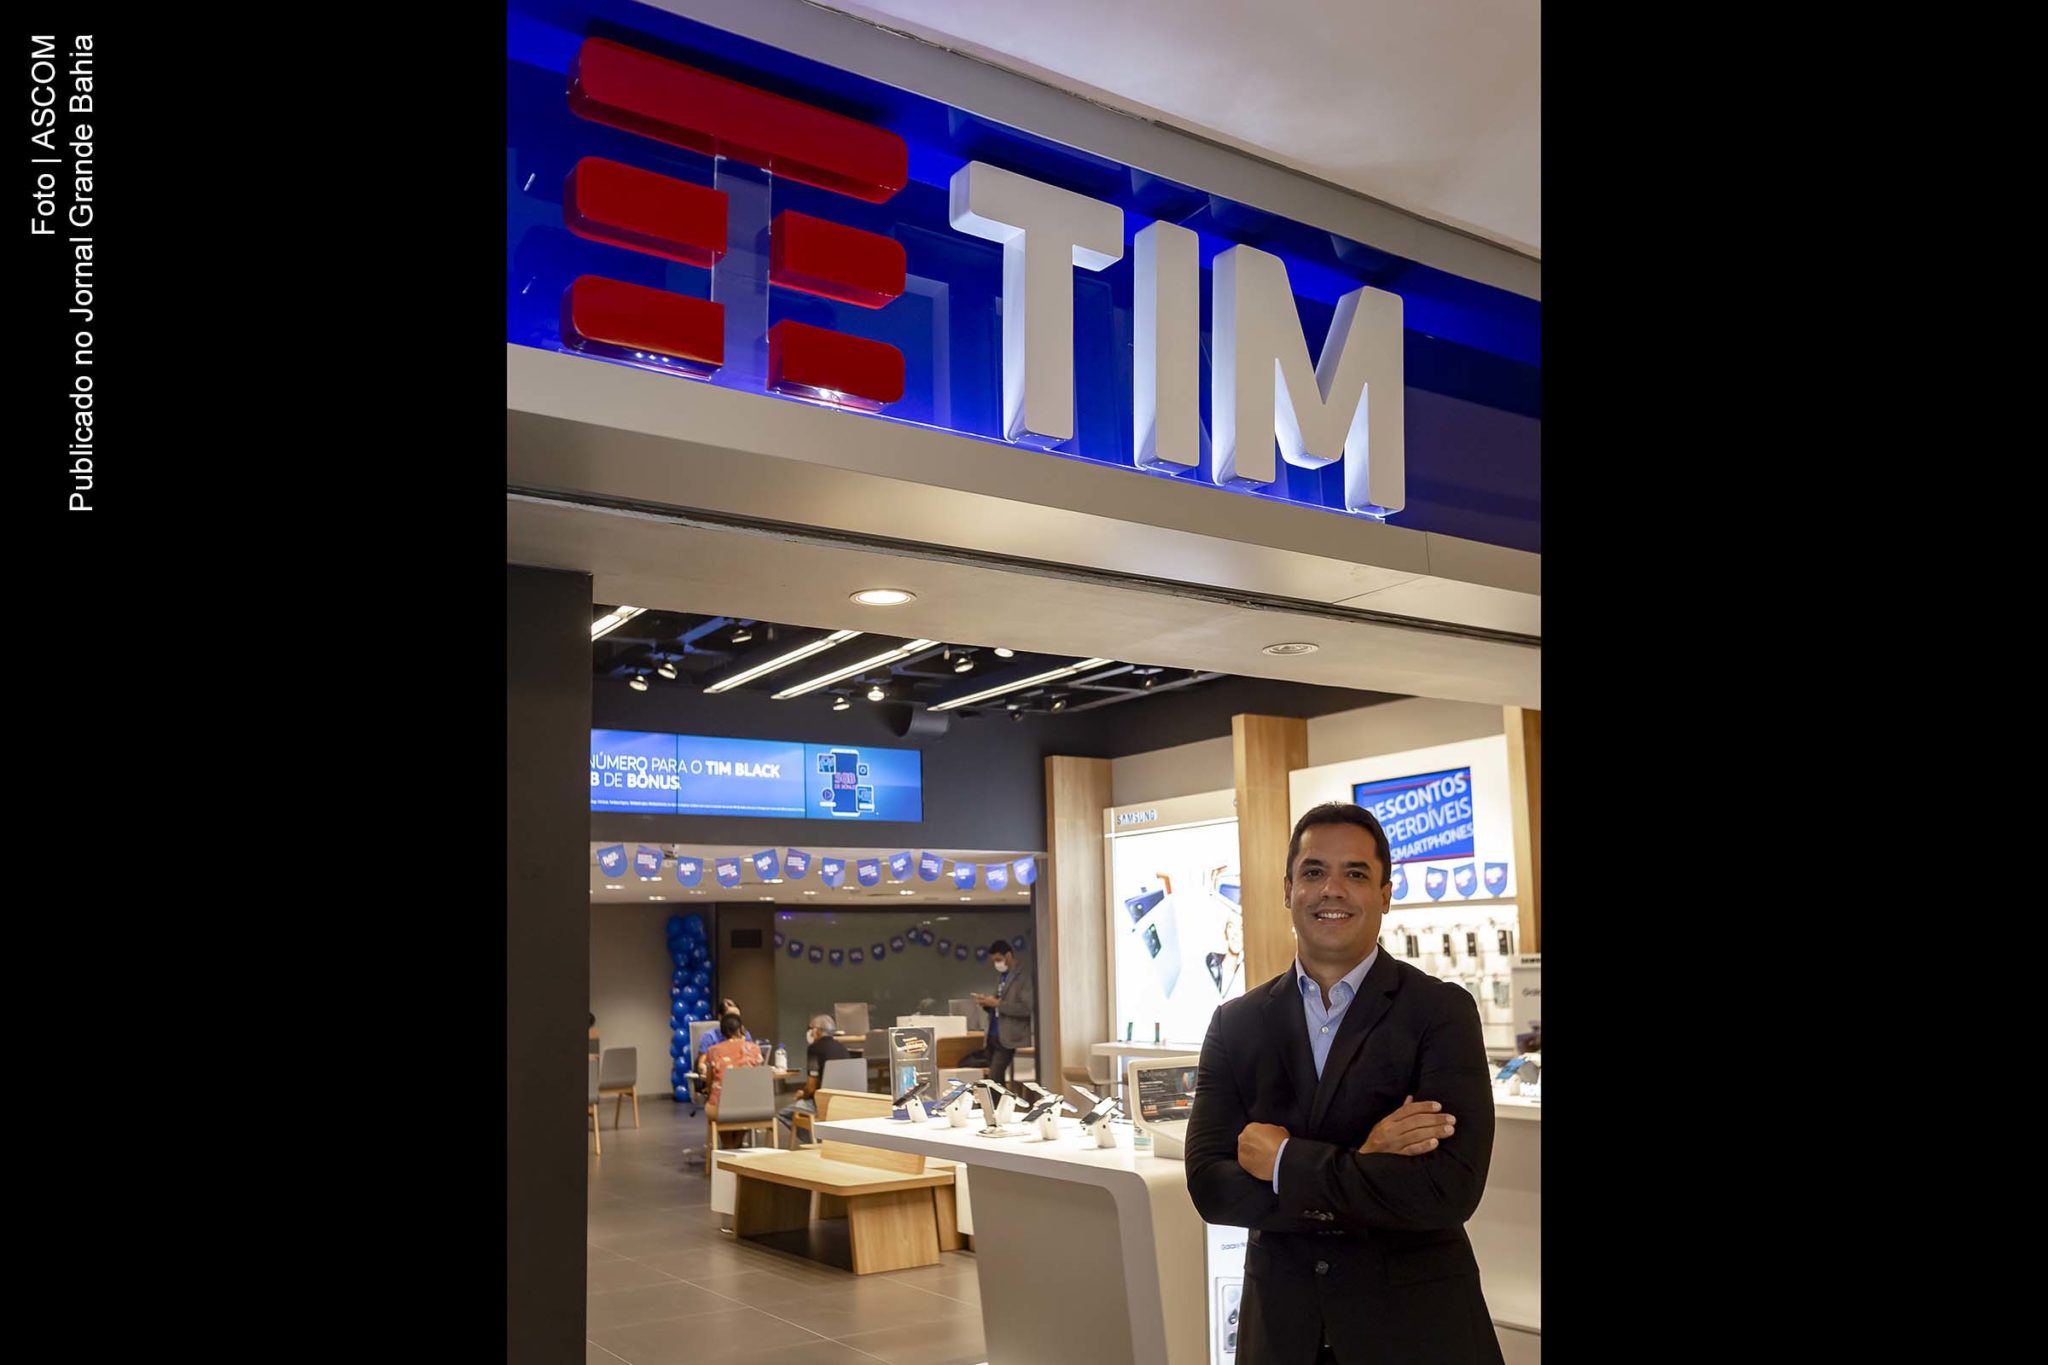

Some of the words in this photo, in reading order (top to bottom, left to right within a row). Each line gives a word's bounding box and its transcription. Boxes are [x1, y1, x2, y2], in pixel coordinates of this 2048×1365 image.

[949, 160, 1405, 517] TIM
[603, 771, 624, 788] DE
[651, 757, 688, 775] PARA
[690, 759, 703, 775] O
[705, 760, 732, 776] TIM
[735, 761, 781, 779] BLACK
[1116, 809, 1157, 826] SAMSUNG
[1383, 796, 1472, 845] PERDÍVEIS
[1390, 821, 1474, 863] SMARTPHONES
